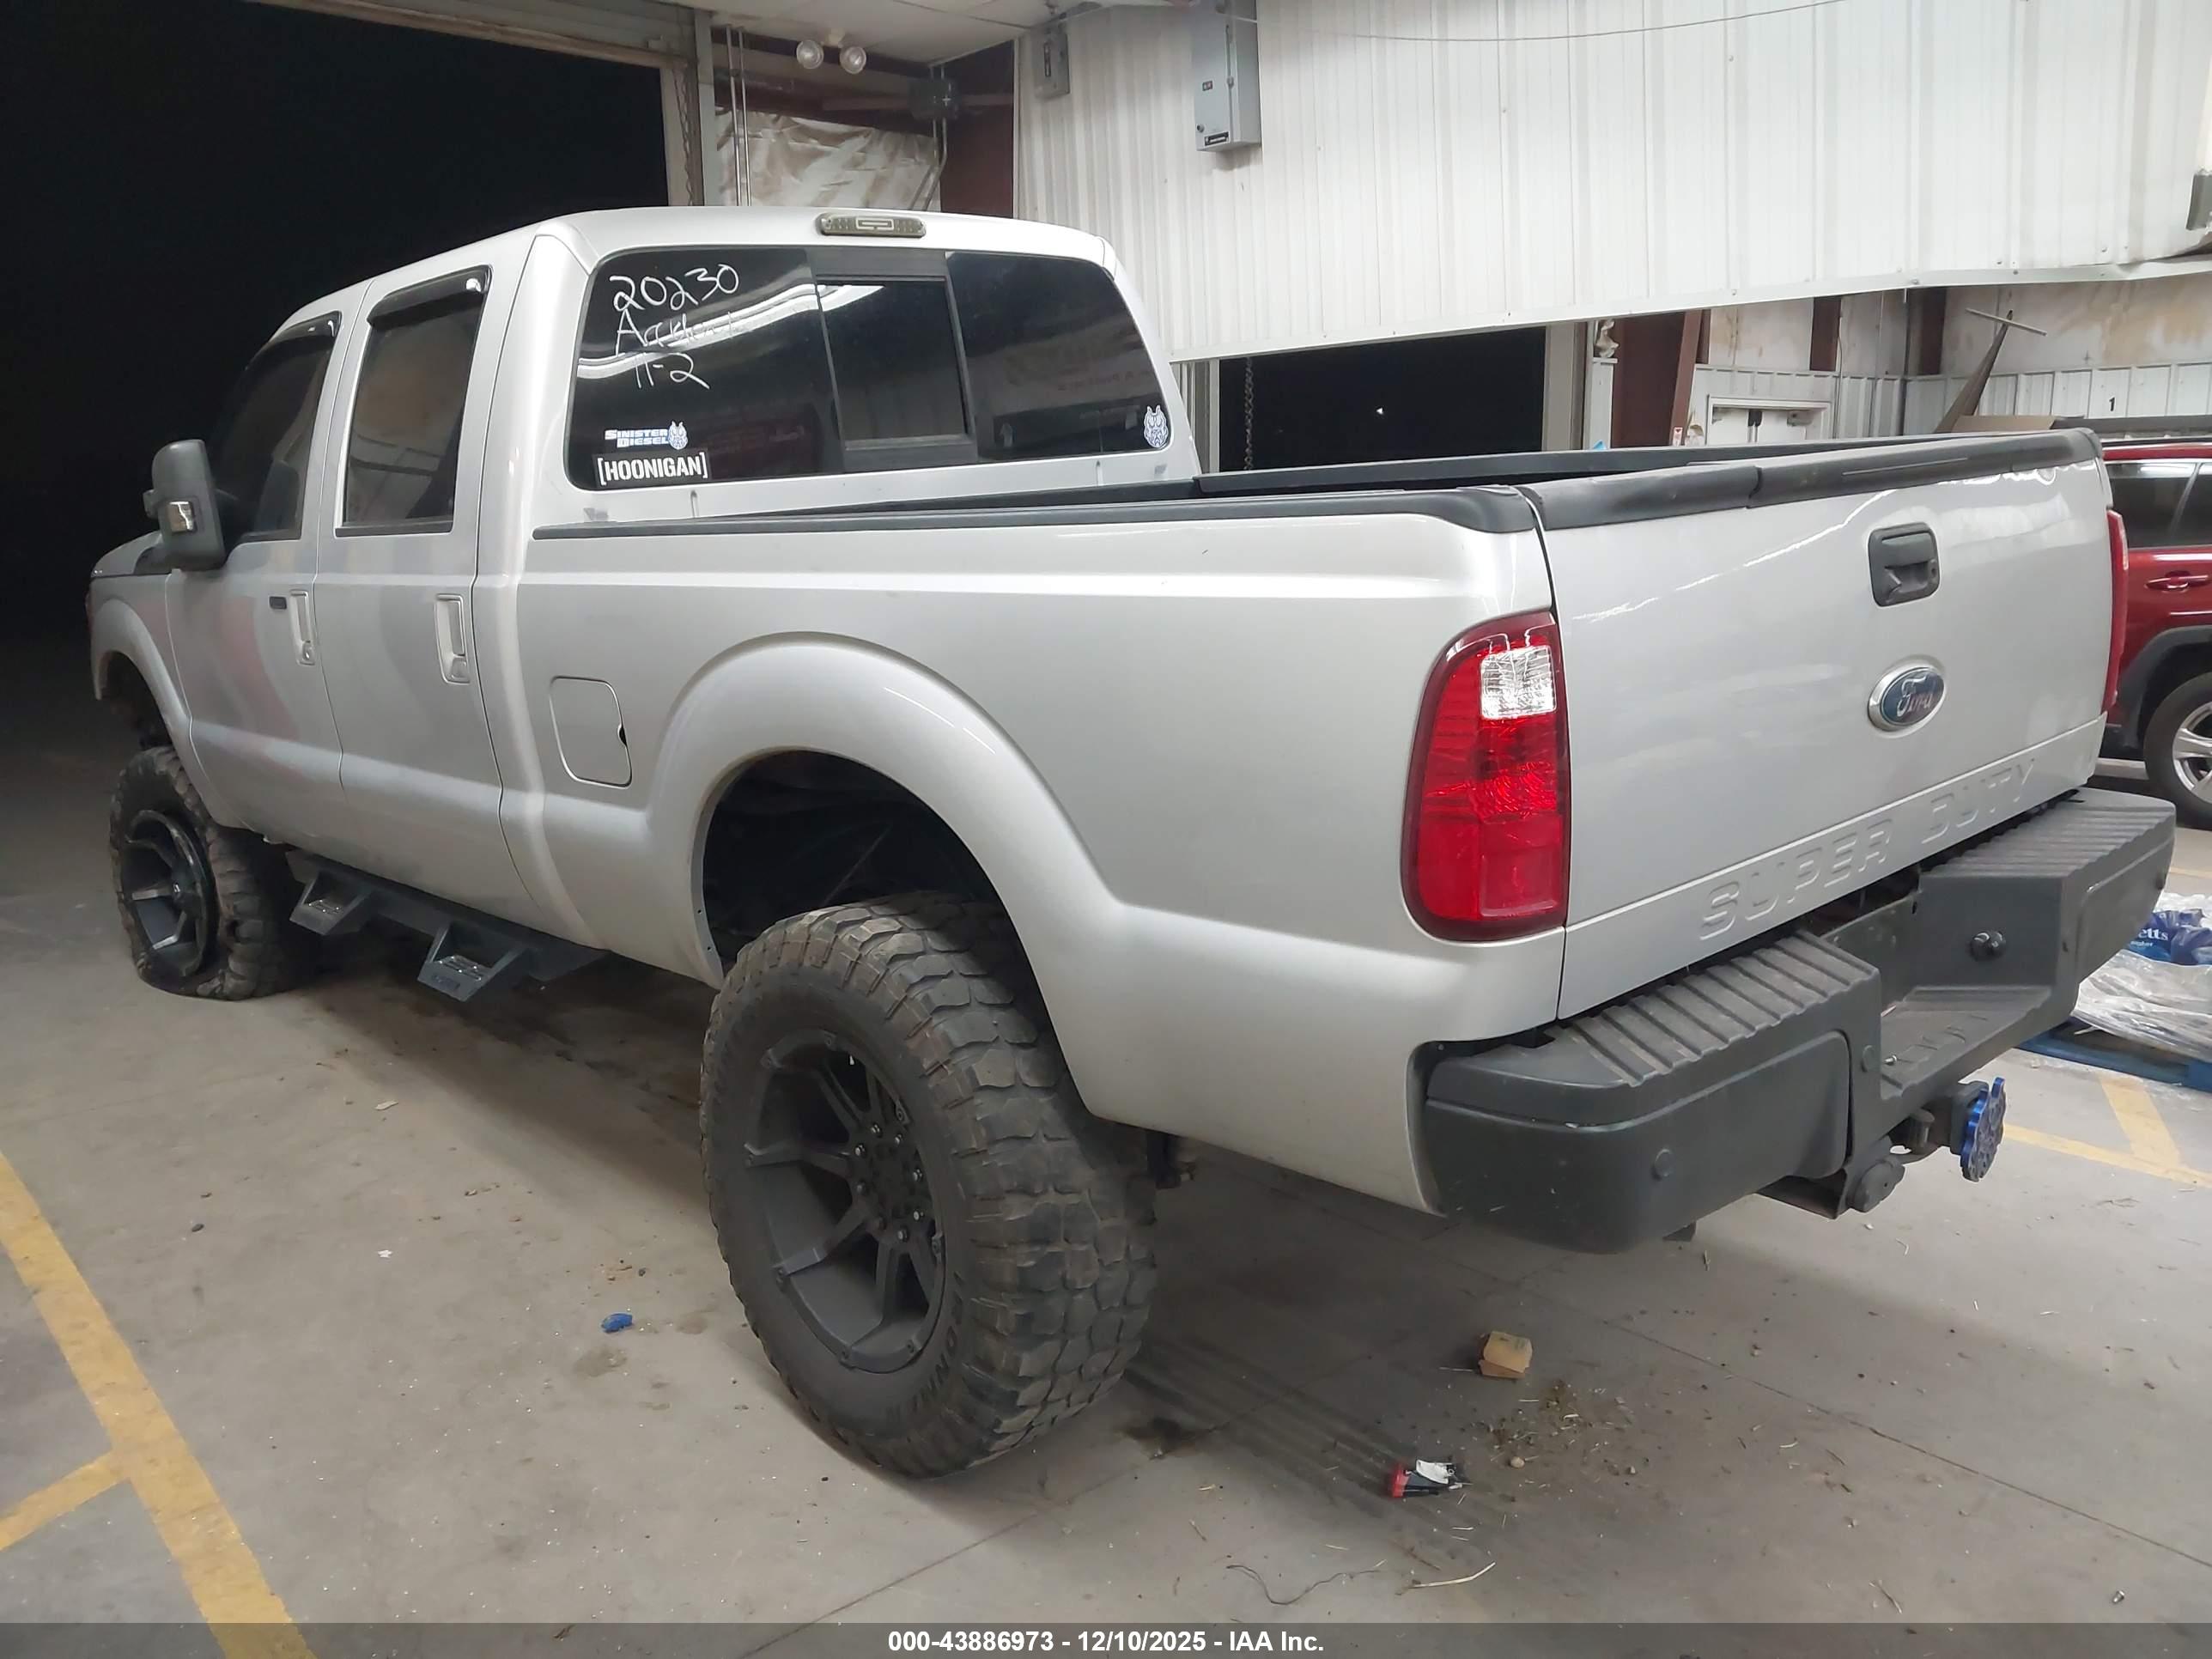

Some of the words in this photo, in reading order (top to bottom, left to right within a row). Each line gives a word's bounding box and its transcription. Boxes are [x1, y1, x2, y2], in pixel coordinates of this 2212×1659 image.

[609, 264, 739, 312] 20230
[2109, 397, 2115, 412] 1
[617, 436, 670, 447] DIESEL
[1896, 674, 1934, 718] Ford
[1698, 818, 1893, 942] SUPER
[1920, 757, 2035, 845] DUTY
